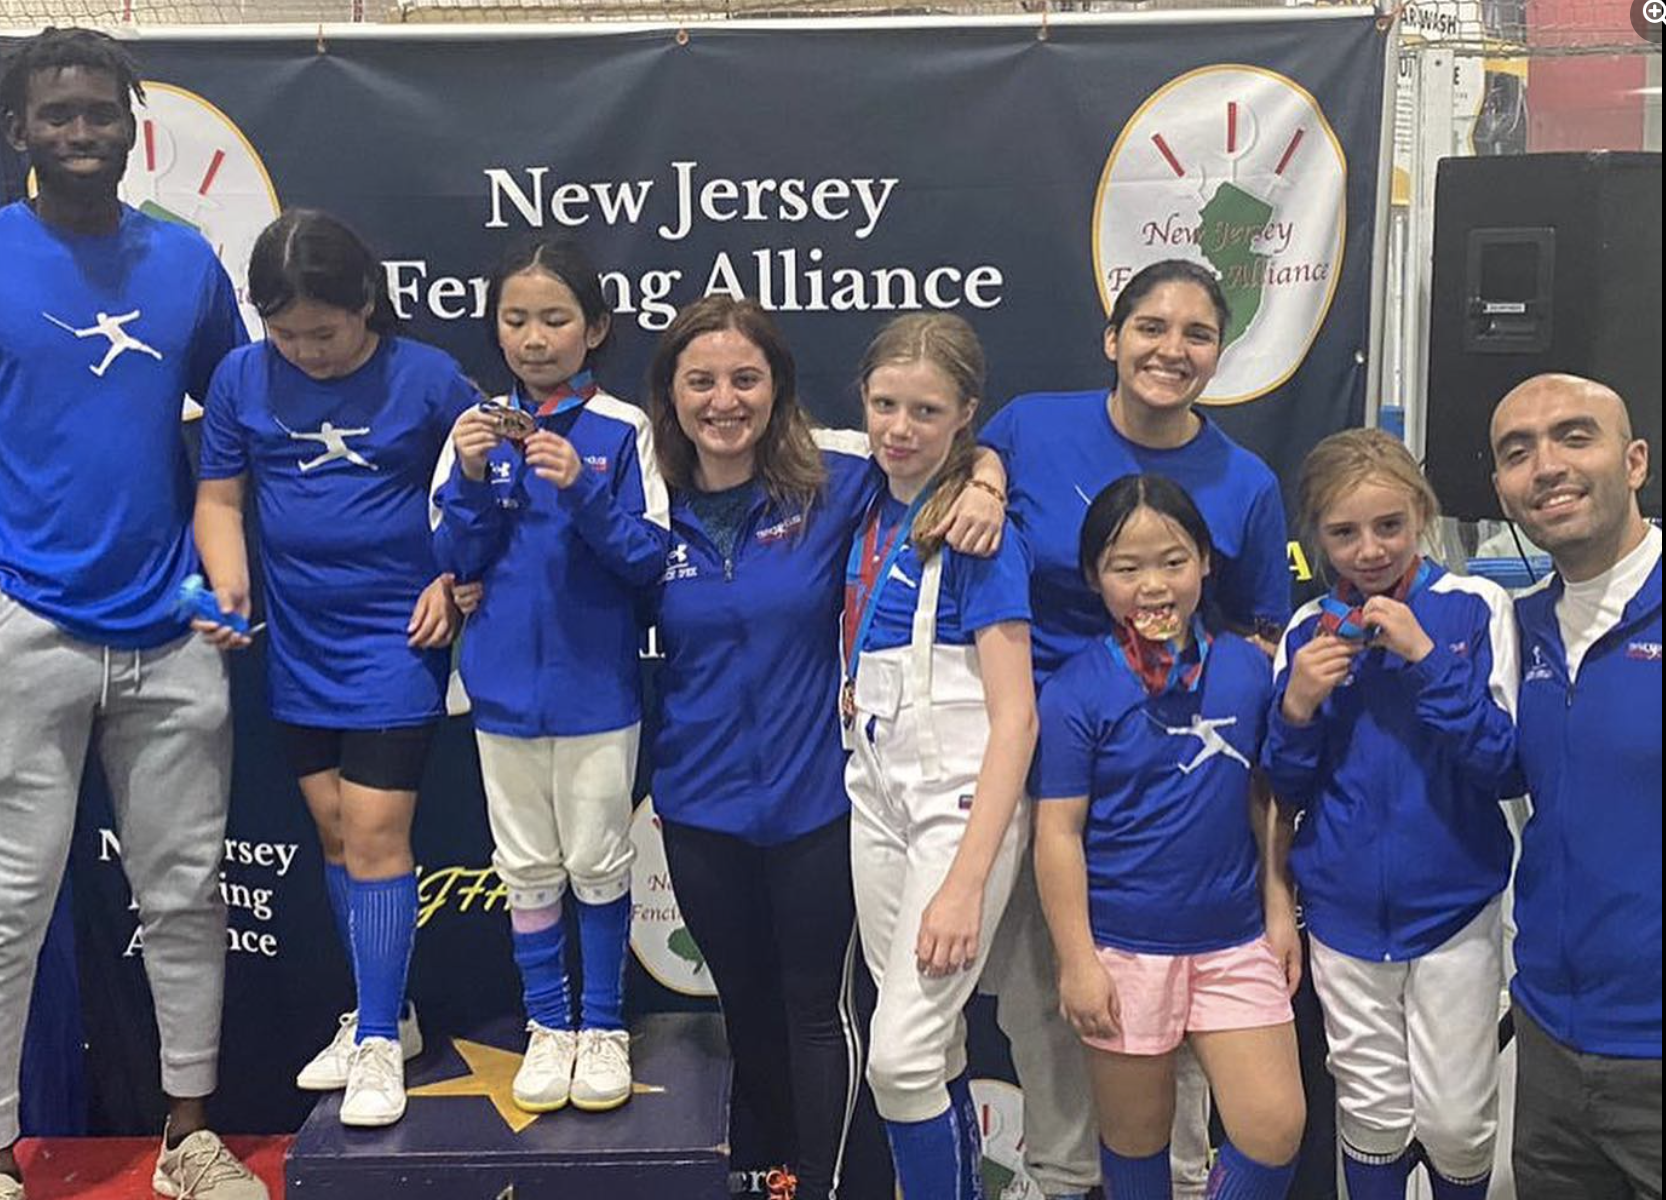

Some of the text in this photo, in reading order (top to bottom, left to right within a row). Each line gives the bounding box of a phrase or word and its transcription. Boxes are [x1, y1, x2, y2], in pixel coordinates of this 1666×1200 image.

[484, 161, 898, 240] New Jersey
[1142, 213, 1293, 254] New Jersey
[382, 248, 1004, 331] Fenng Alliance
[224, 838, 298, 876] rsey
[416, 865, 512, 929] JFA
[630, 903, 680, 921] Fenci
